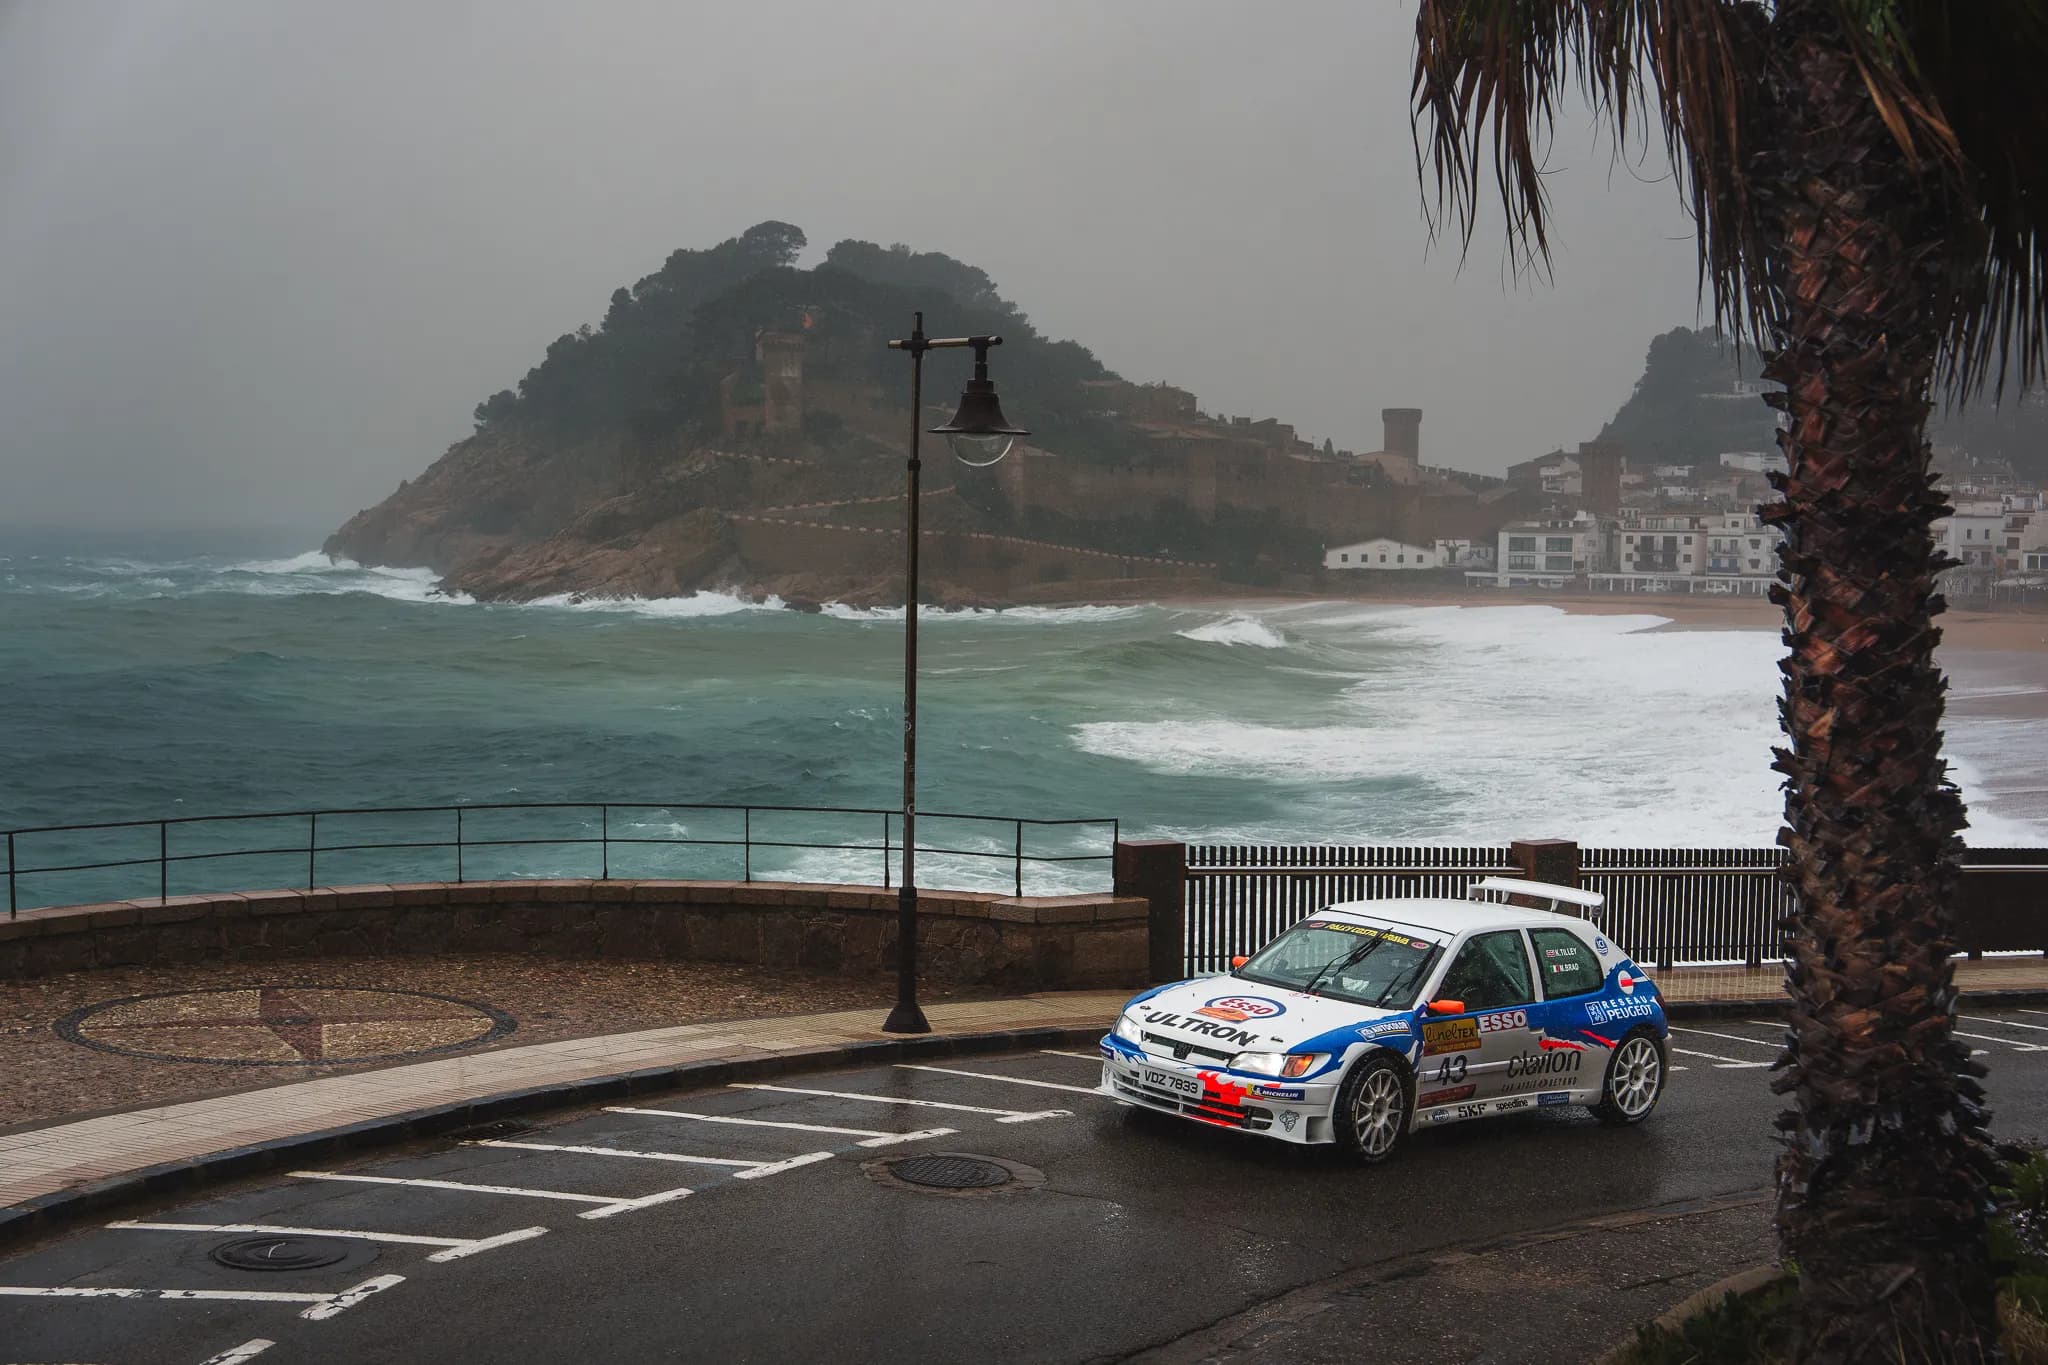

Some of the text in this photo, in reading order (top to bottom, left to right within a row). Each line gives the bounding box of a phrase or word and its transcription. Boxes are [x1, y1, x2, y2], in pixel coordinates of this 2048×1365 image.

[1603, 995, 1647, 1009] RESEAU
[1607, 1004, 1653, 1021] PEUGEOT
[1145, 1011, 1260, 1047] ULTRON
[1479, 1011, 1526, 1033] ESSO
[1436, 1055, 1468, 1086] 43
[1144, 1069, 1199, 1094] VDZ 7833
[1262, 1090, 1299, 1098] MICHELIN
[1458, 1103, 1487, 1119] SKF
[1496, 1097, 1529, 1112] speedline
